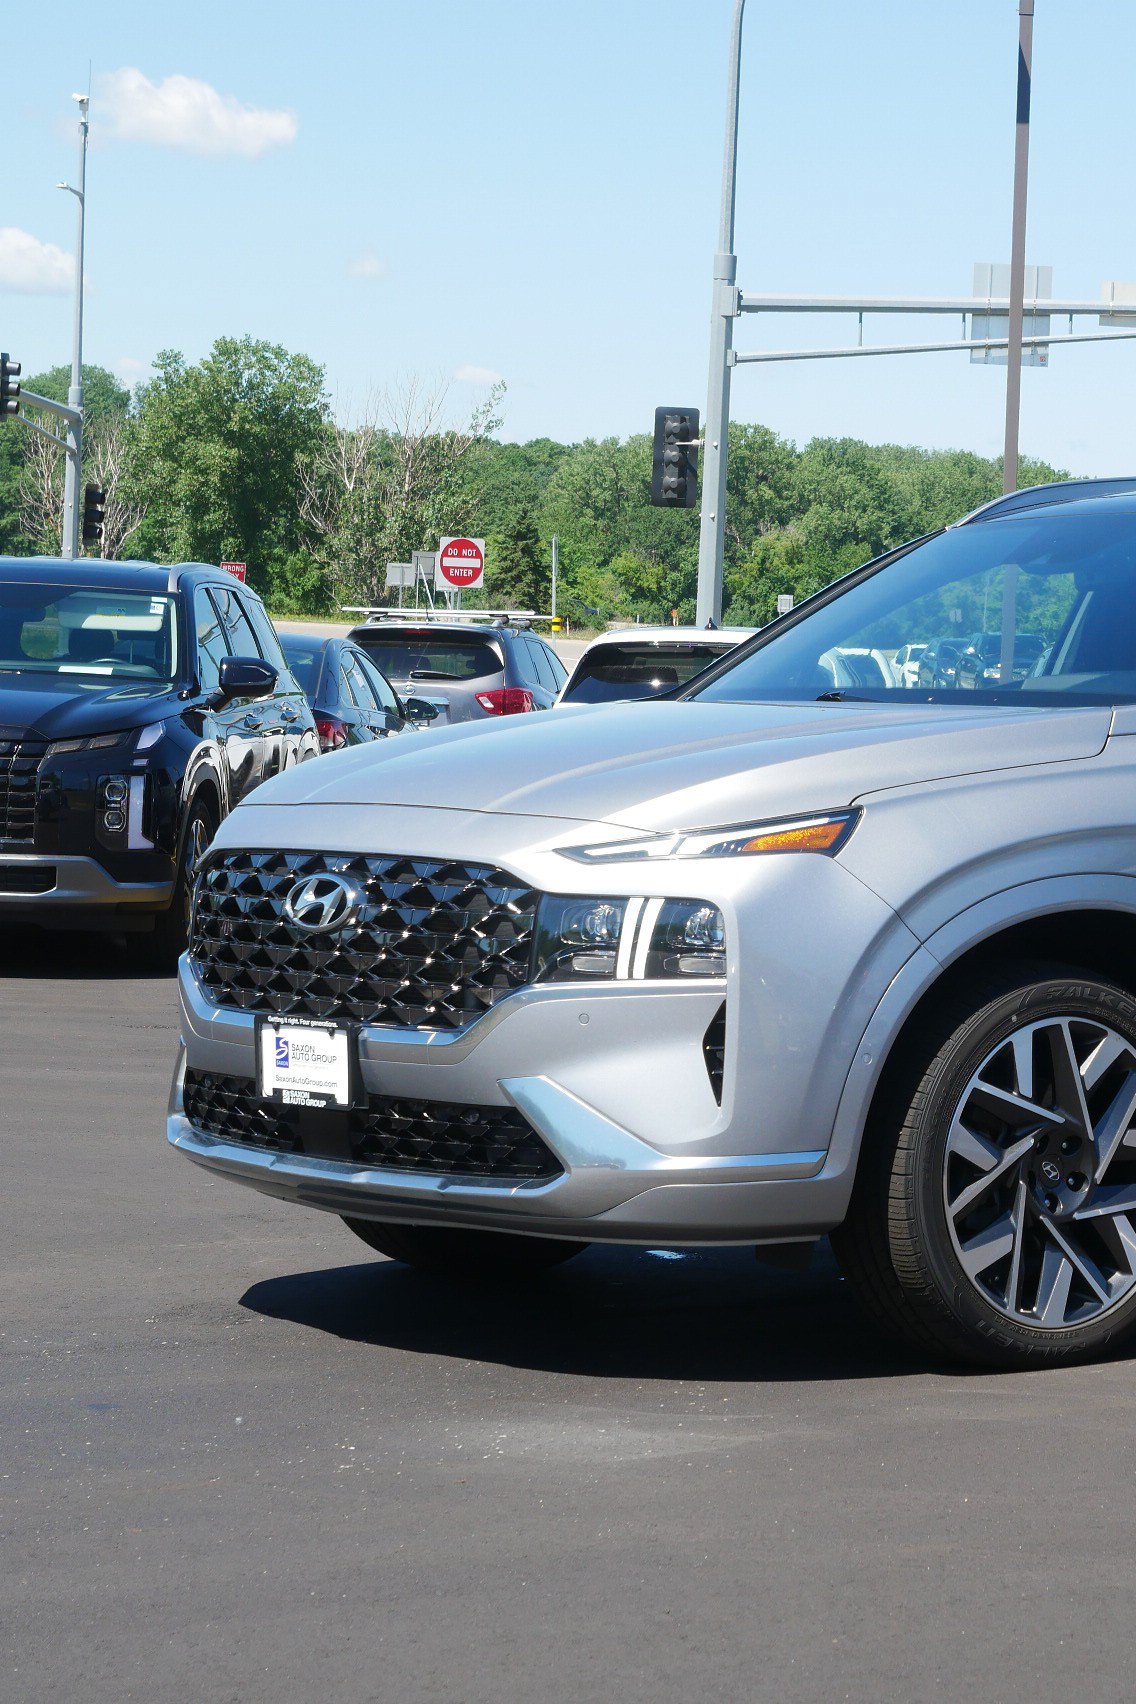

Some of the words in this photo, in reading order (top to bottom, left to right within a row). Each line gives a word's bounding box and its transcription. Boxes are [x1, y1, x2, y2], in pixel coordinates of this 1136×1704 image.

[448, 548, 458, 556] DO
[462, 549, 477, 557] NOT
[449, 568, 473, 577] ENTER
[291, 1044, 315, 1053] SAXON
[291, 1053, 310, 1061] AUTO
[311, 1053, 338, 1064] GROUP
[275, 1075, 338, 1087] SaxonAutoGroup.com
[289, 1090, 310, 1099] SAXON
[288, 1096, 305, 1105] AUTO
[306, 1098, 327, 1108] GROUP
